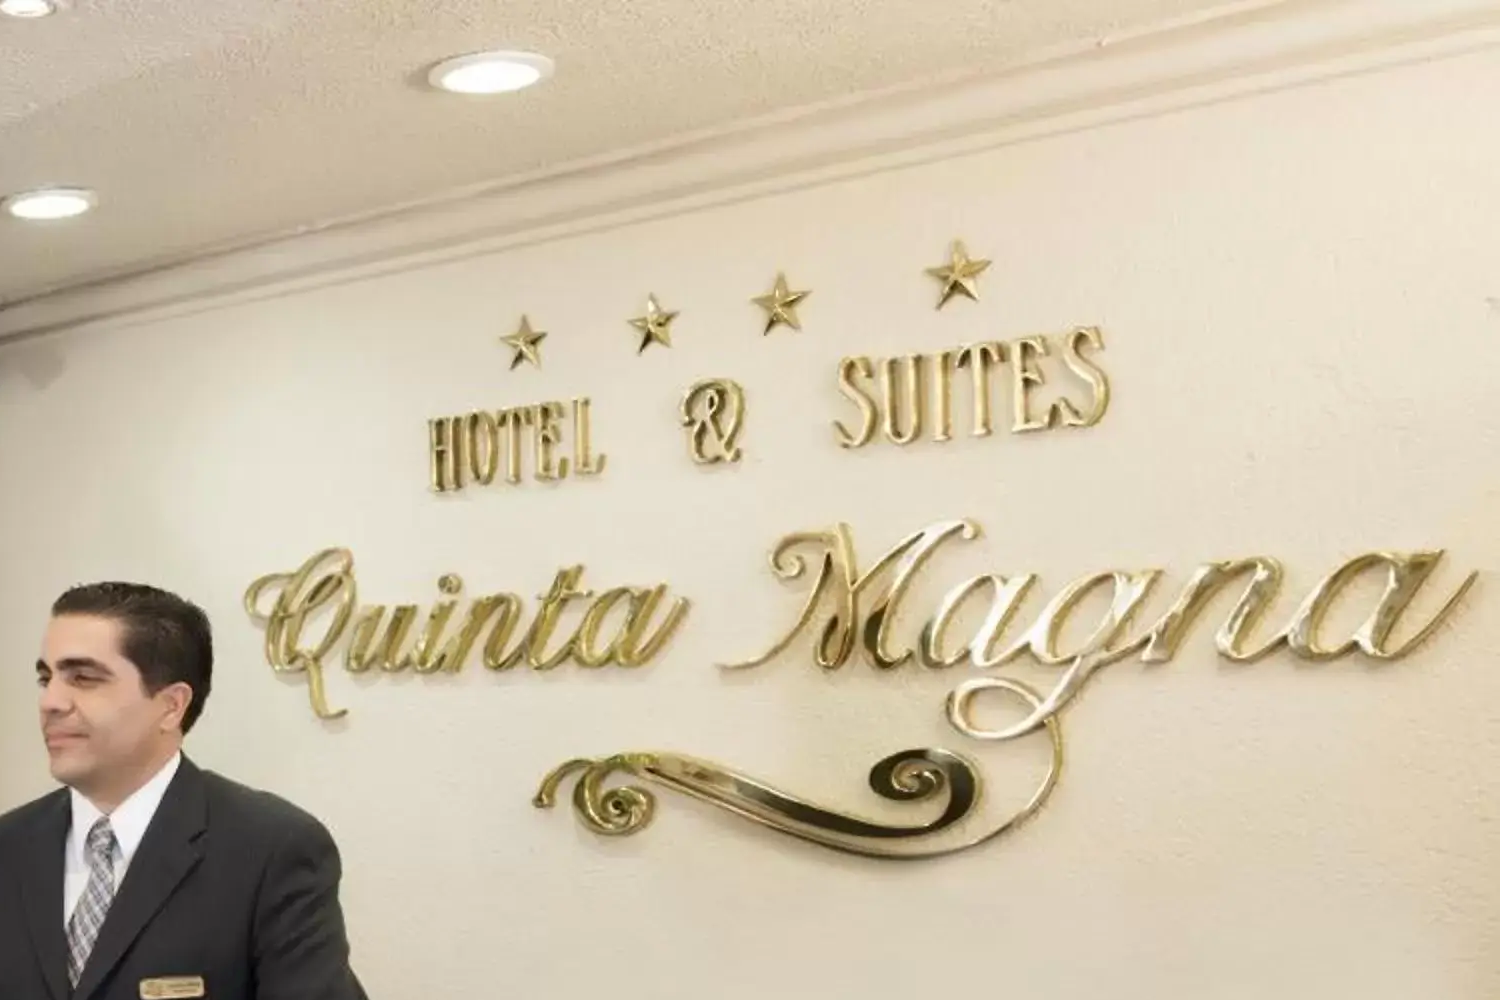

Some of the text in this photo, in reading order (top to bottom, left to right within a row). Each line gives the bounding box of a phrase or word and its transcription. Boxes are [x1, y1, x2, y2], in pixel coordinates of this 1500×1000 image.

[428, 325, 1111, 493] HOTEL & SUITES
[243, 517, 1479, 740] Quinta Magna
